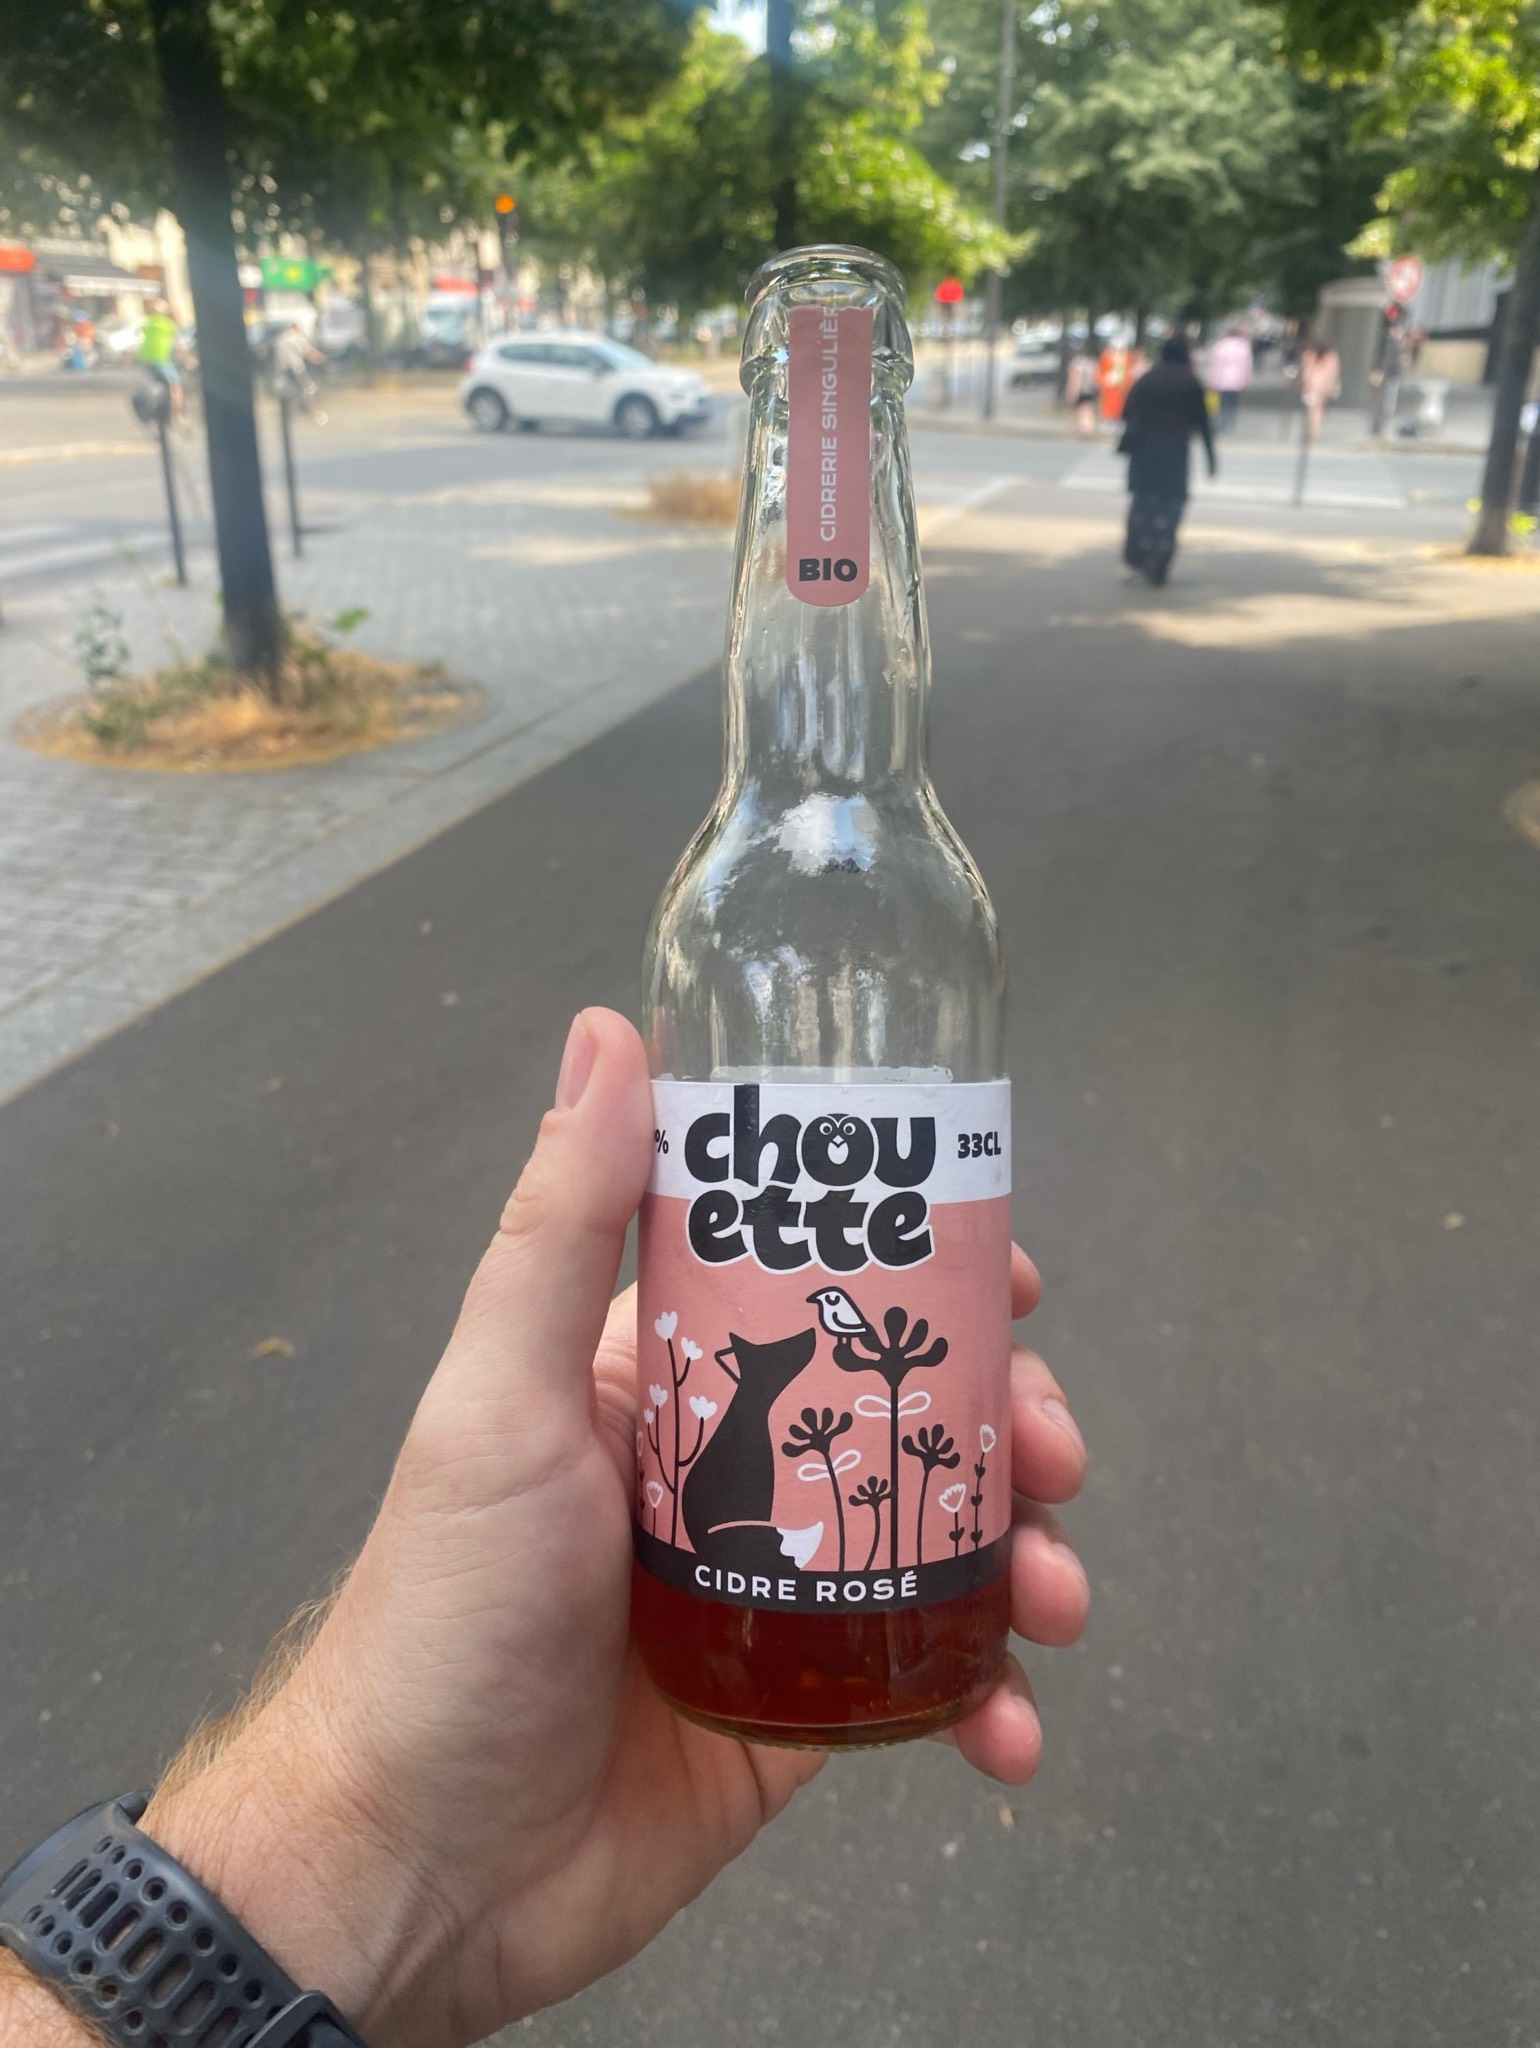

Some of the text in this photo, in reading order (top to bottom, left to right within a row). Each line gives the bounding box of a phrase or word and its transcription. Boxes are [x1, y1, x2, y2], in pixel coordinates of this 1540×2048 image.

[821, 436, 837, 542] CIDRERIE
[798, 559, 858, 582] BIO
[685, 1084, 936, 1187] chou
[957, 1132, 1002, 1159] 33CL
[688, 1185, 934, 1272] ette
[694, 1565, 918, 1602] CIDRE ROSÉ
